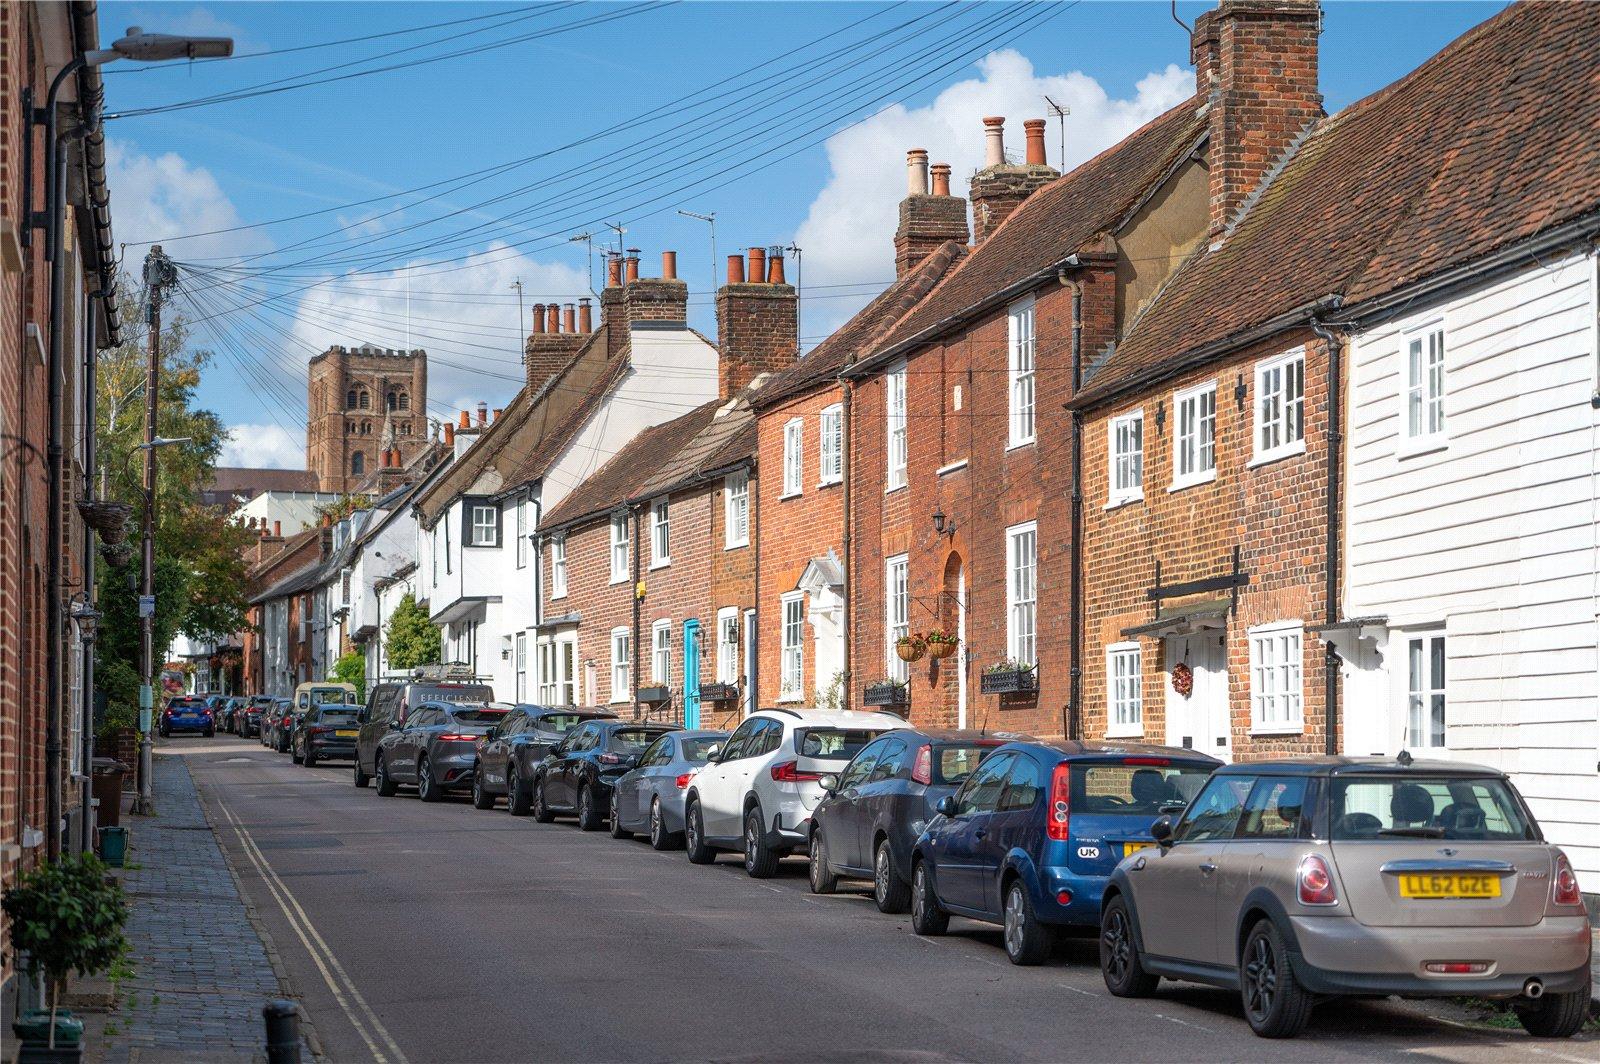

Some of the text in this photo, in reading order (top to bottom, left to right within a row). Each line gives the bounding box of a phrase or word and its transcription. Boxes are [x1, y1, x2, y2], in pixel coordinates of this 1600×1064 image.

[420, 694, 481, 703] EFFICIENT
[1080, 848, 1096, 857] UK
[1406, 875, 1492, 894] LL62 GZE
